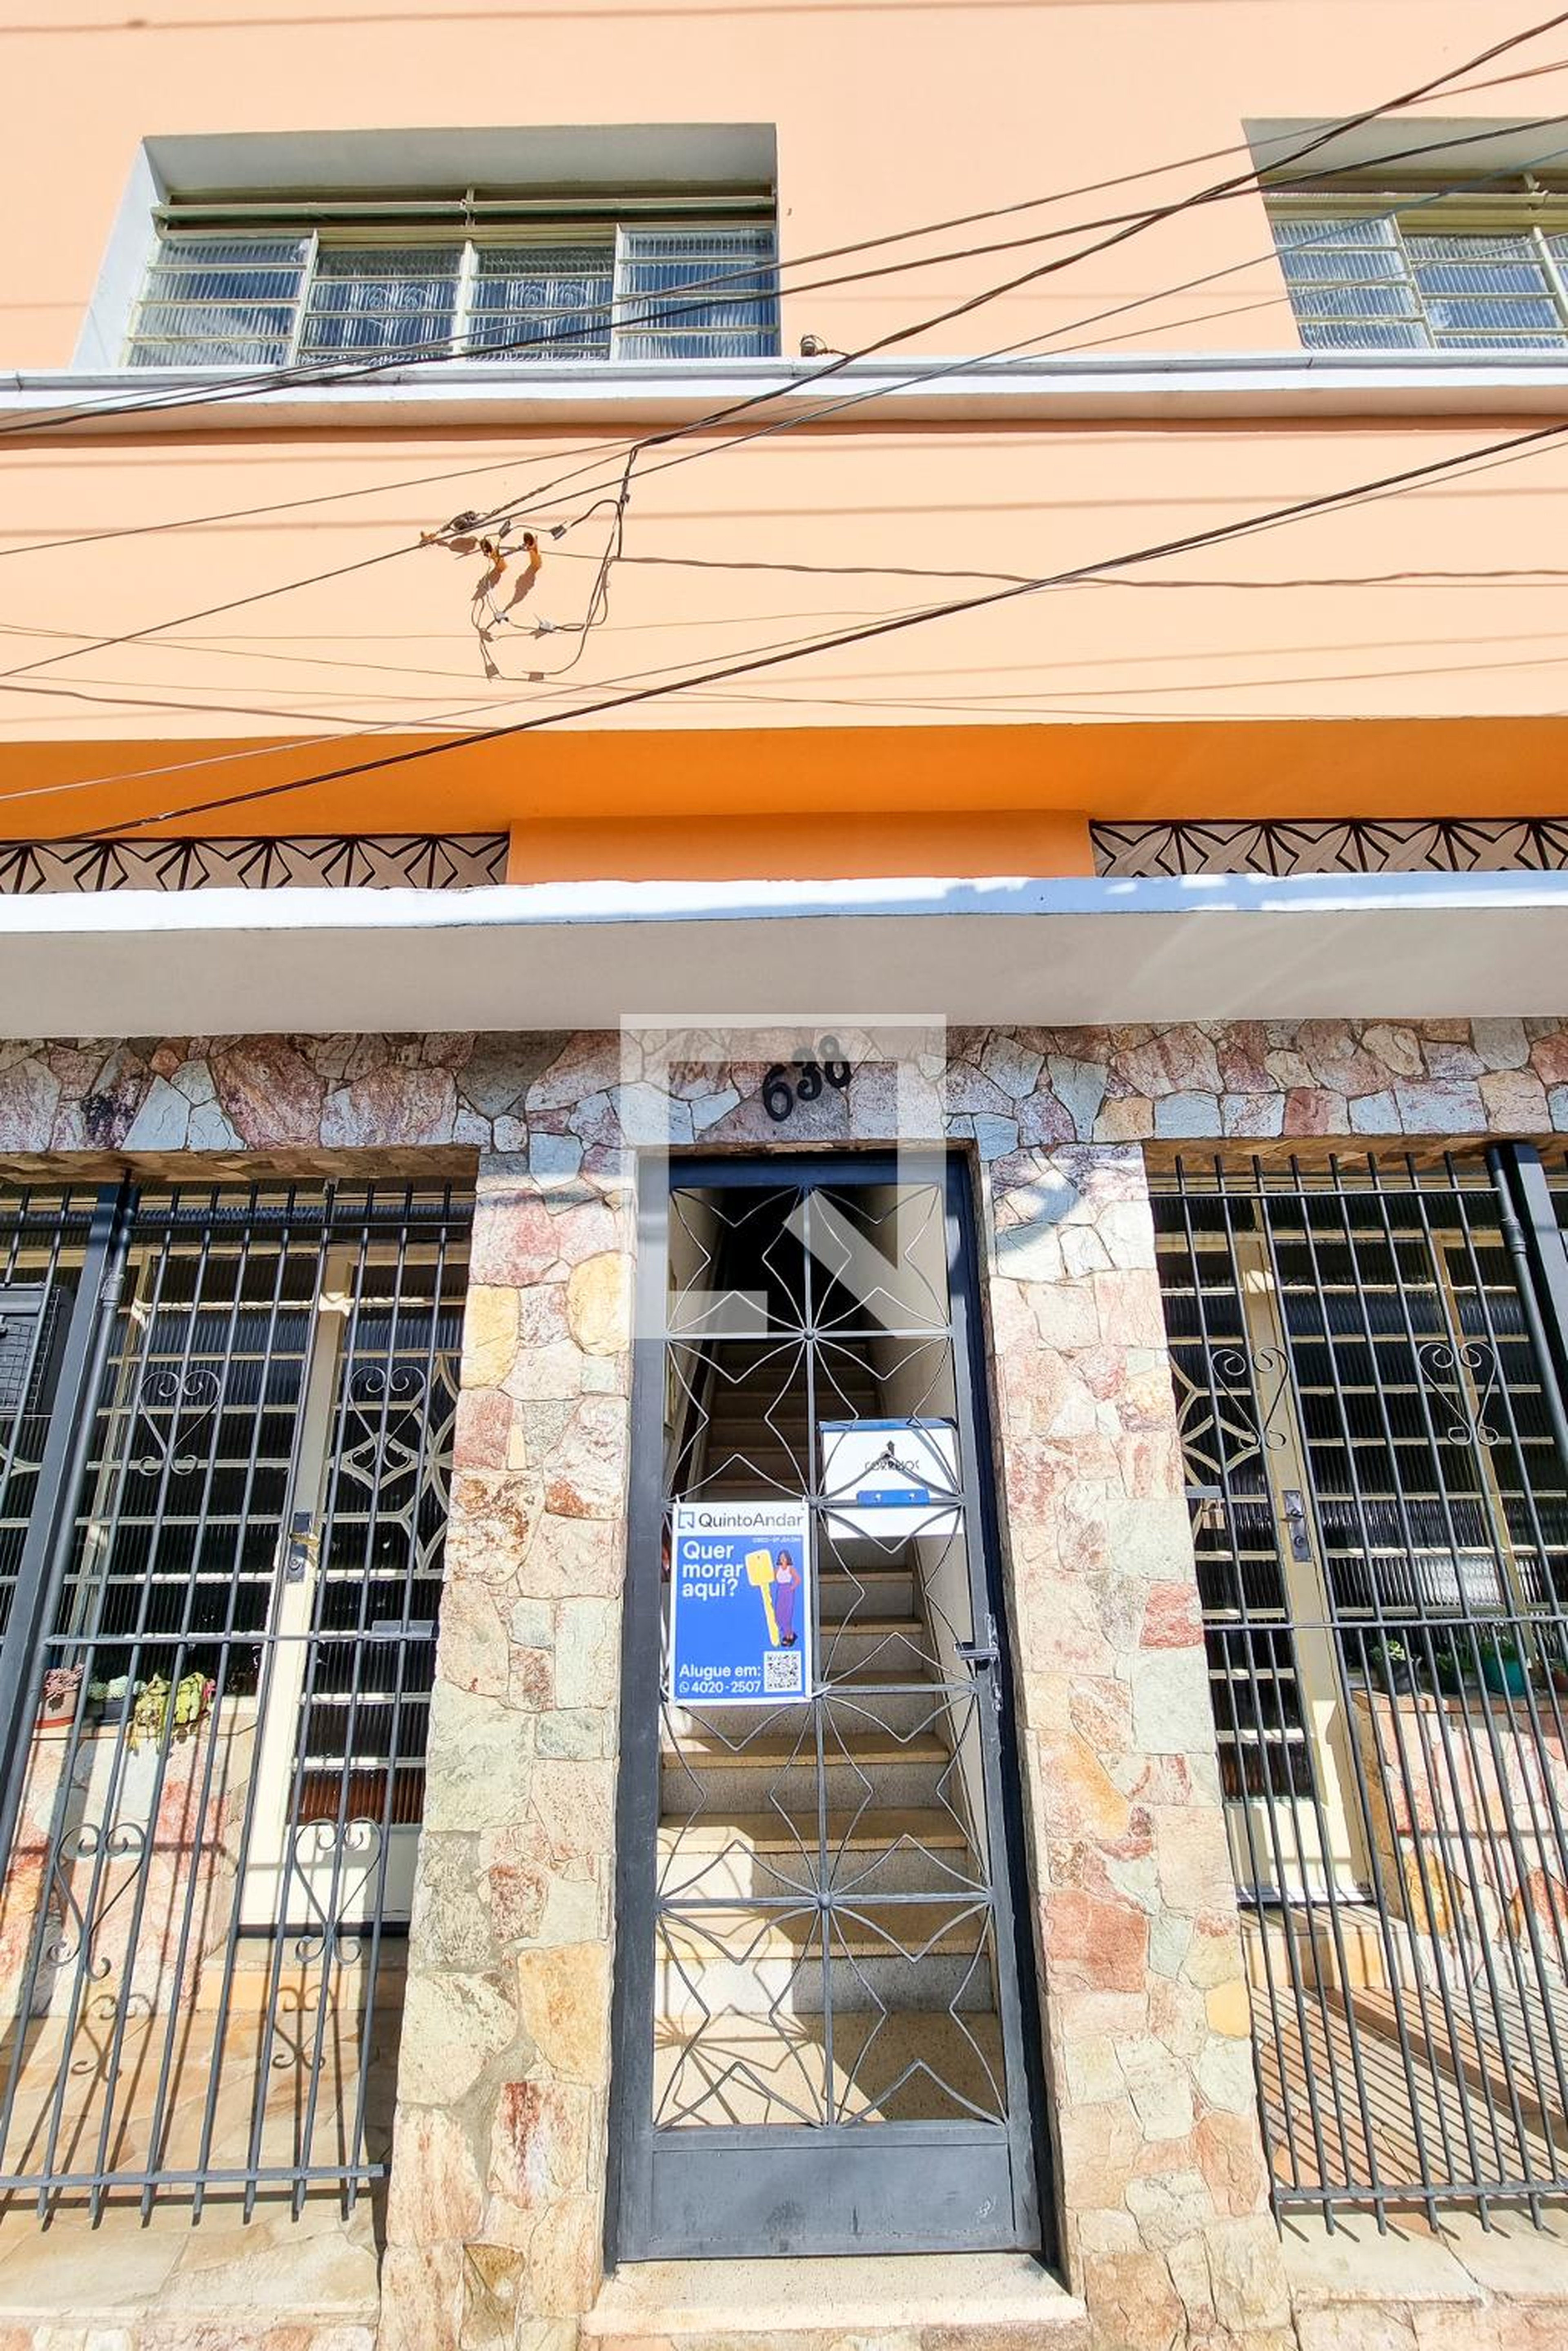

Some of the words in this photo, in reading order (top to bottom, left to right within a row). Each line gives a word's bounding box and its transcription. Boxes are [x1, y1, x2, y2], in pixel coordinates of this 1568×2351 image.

[762, 1035, 851, 1122] 638
[699, 1512, 804, 1528] QuintoAndar
[683, 1540, 734, 1560] Quer
[682, 1564, 744, 1579] morar
[682, 1579, 738, 1601] aqui?
[679, 1664, 731, 1681] Alugue
[735, 1666, 761, 1677] em:
